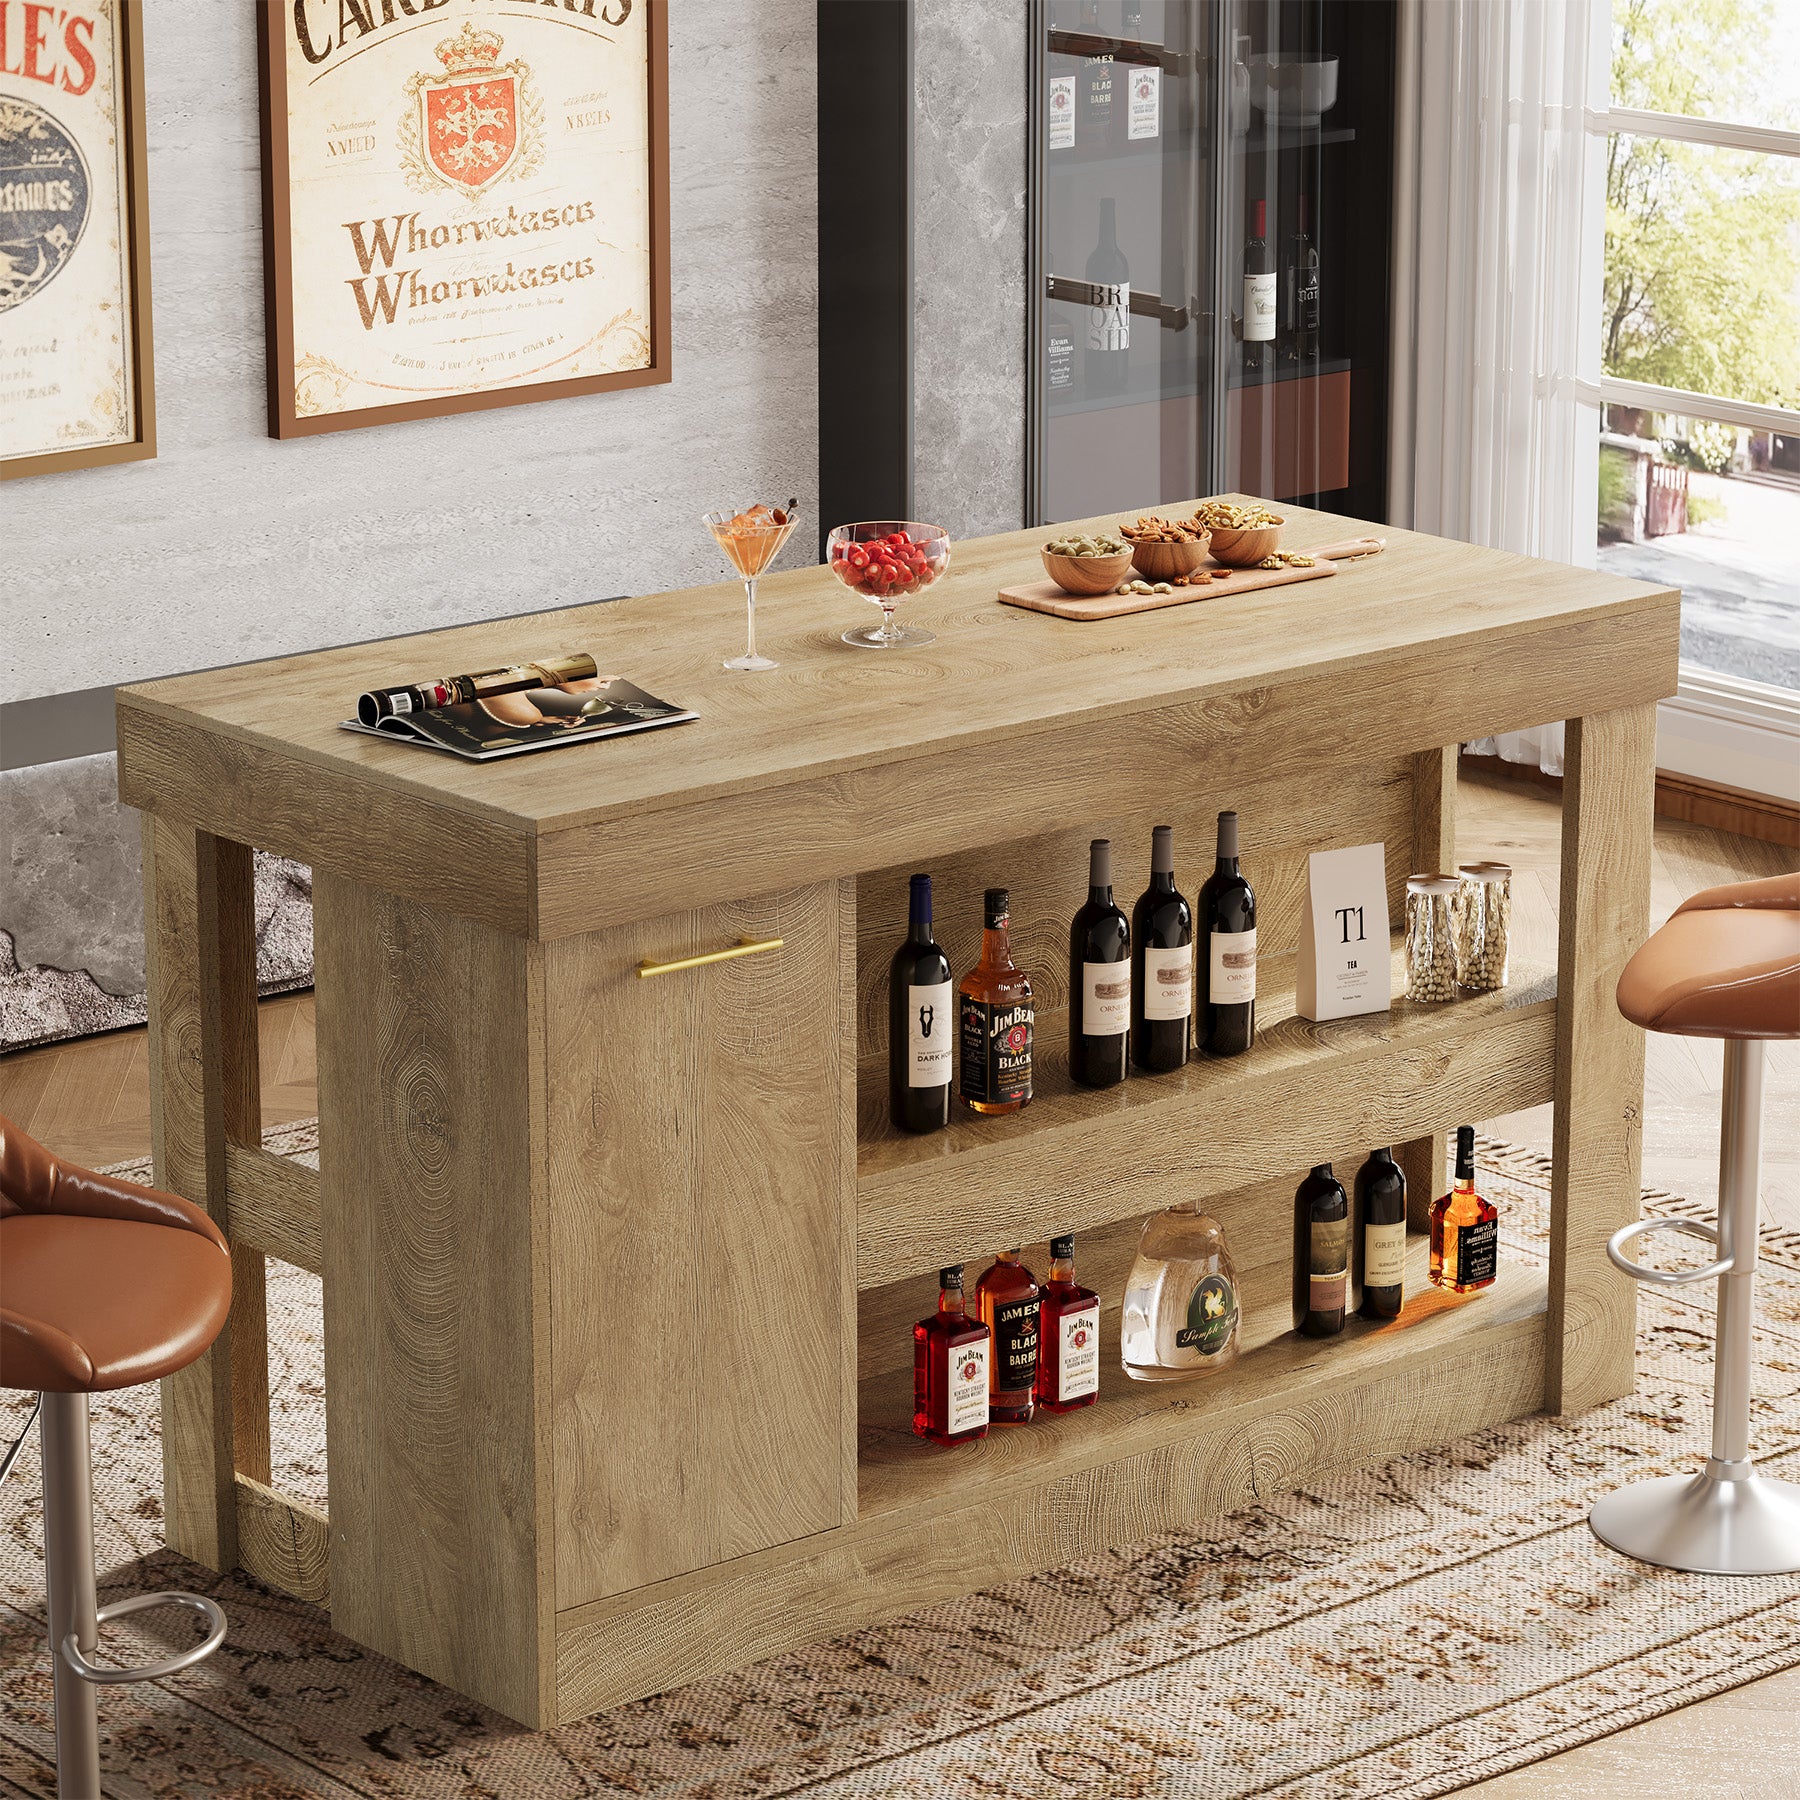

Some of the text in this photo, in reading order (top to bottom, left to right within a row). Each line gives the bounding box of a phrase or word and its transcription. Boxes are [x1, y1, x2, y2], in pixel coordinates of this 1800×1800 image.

[1085, 54, 1114, 67] JAMES
[1092, 81, 1112, 90] BLAC
[1335, 906, 1367, 943] T1
[1347, 960, 1357, 969] TEA
[964, 1023, 982, 1035] BLACK
[990, 1013, 1012, 1037] JIM
[999, 1053, 1031, 1069] BLACK
[1002, 1302, 1040, 1322] JAMES
[1067, 1319, 1093, 1338] JIM BEAM
[1182, 1323, 1218, 1343] Sample
[1012, 1334, 1037, 1350] BLAC
[956, 1350, 984, 1370] JIM BEAM
